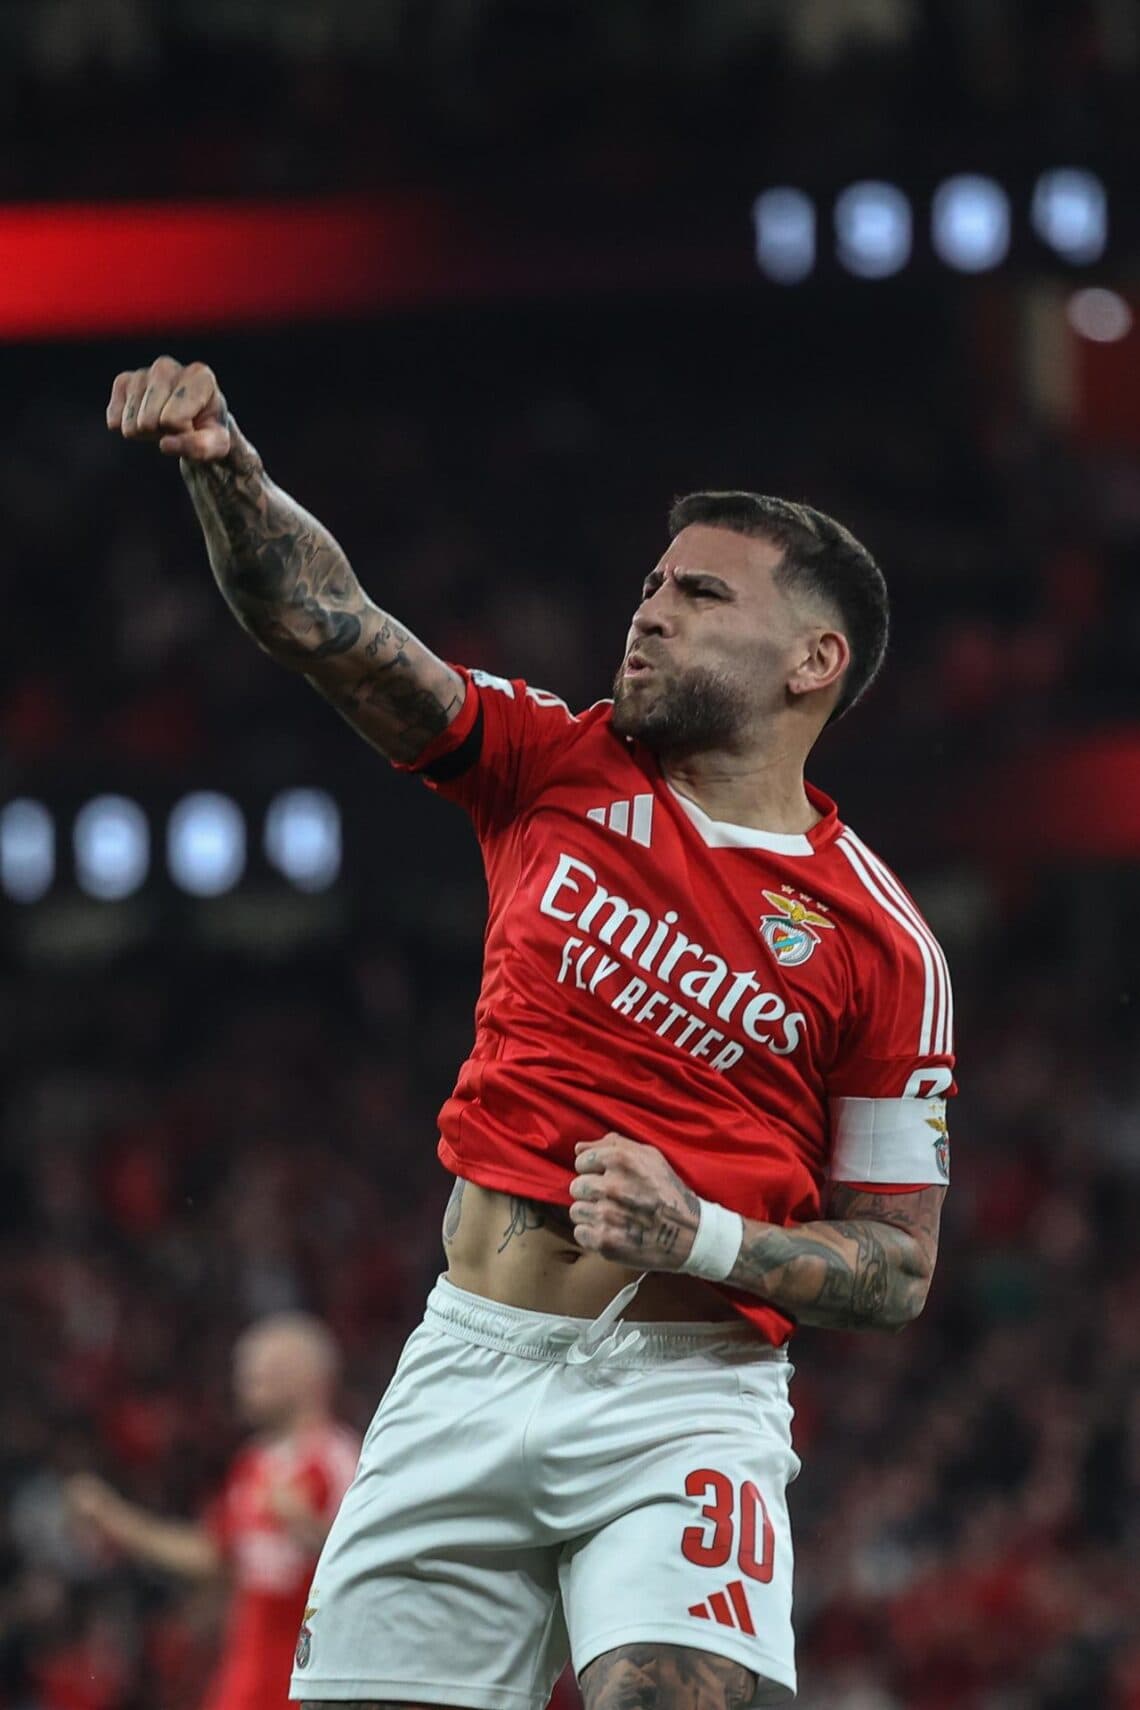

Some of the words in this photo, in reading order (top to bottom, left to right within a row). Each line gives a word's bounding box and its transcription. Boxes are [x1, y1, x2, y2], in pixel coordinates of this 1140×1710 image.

[540, 853, 807, 1055] Emirates
[557, 936, 620, 995] FLY
[611, 975, 745, 1073] BETTER
[681, 1468, 775, 1584] 30
